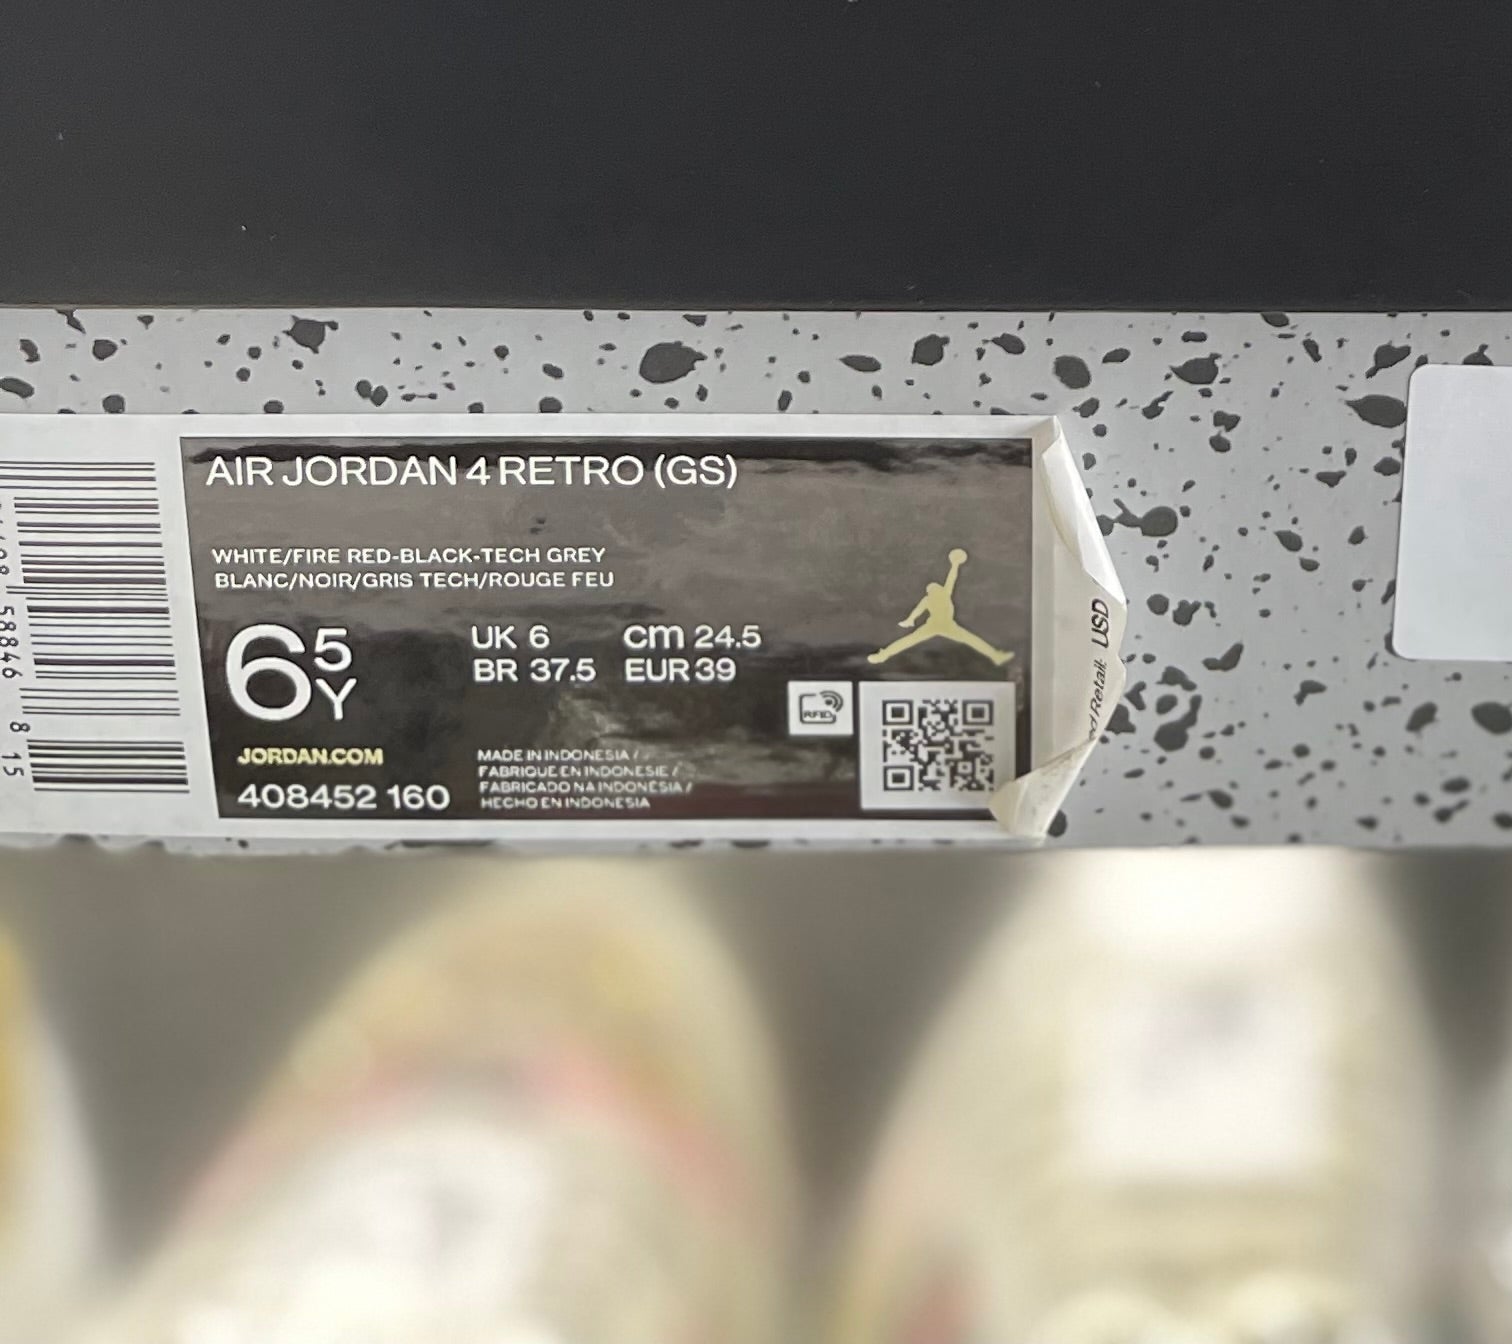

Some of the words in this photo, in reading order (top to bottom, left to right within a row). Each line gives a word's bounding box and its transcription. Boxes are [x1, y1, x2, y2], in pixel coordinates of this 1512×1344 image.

[206, 456, 273, 486] AIR
[281, 455, 457, 486] JORDAN
[465, 456, 490, 486] 4
[500, 455, 645, 486] RETRO
[654, 454, 738, 489] (GS)
[212, 548, 340, 566] WHITE/FIRE
[348, 547, 540, 563] RED-BLACK-TECH
[547, 547, 606, 562] GREY
[215, 572, 413, 591] BLANC/NOIR/GRIS
[419, 571, 565, 589] TECH/ROUGE
[572, 571, 614, 587] FEU
[1091, 598, 1109, 649] USD
[471, 625, 517, 649] UK
[529, 625, 550, 649] 6
[694, 625, 761, 649] 24.5
[473, 658, 518, 682] BR
[531, 658, 596, 682] 37.5
[625, 658, 690, 682] EUR
[695, 658, 736, 682] 39
[315, 678, 357, 720] Y
[237, 747, 384, 766] JORDAN.COM
[478, 749, 523, 761] MADE
[527, 749, 542, 761] IN
[545, 749, 630, 761] INDONESIA
[561, 765, 582, 777] EN
[237, 784, 378, 810] 408452
[387, 784, 450, 810] 160
[480, 781, 570, 793] FABRICADO
[574, 781, 595, 793] NA
[481, 797, 538, 809] HECHO
[541, 797, 562, 809] EN
[565, 797, 650, 809] INDONESIA
